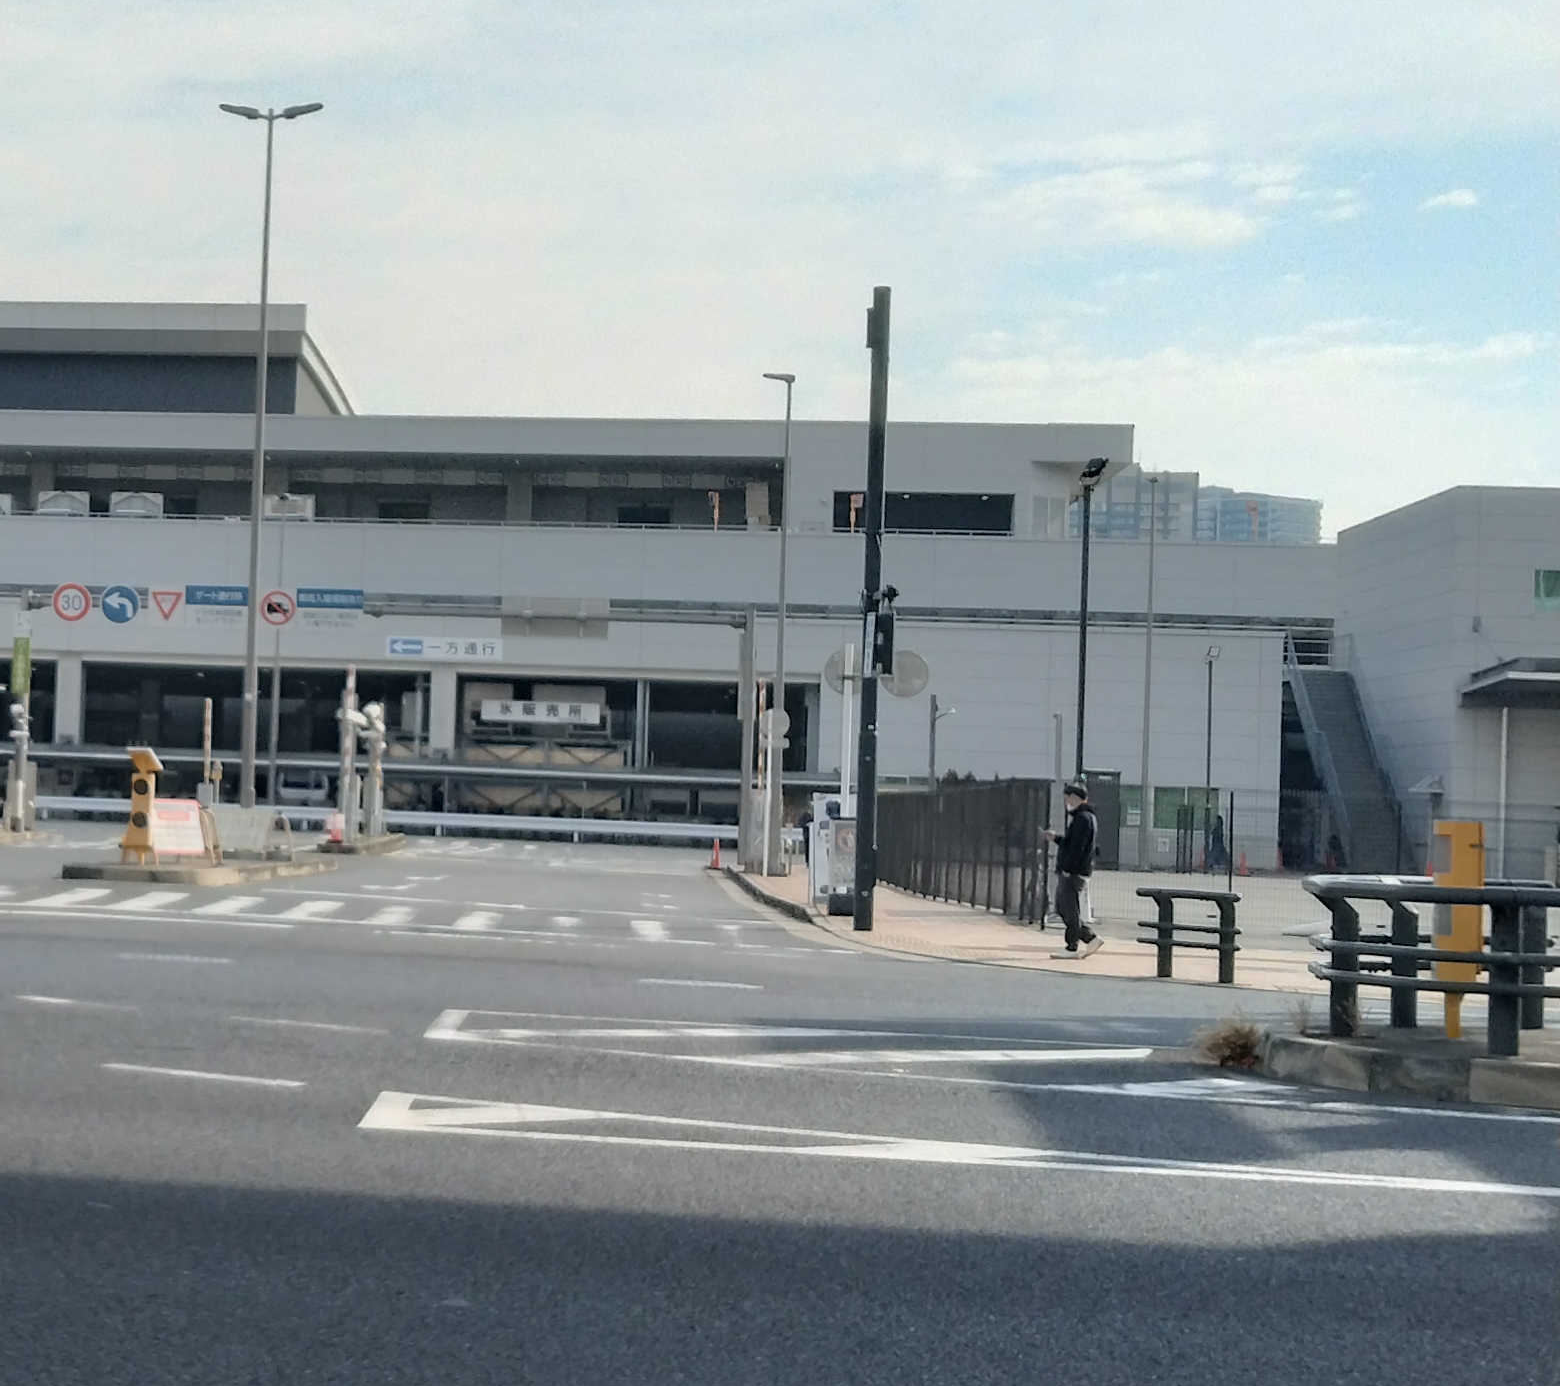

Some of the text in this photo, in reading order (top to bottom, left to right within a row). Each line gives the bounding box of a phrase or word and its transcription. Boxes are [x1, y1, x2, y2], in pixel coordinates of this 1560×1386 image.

[61, 594, 83, 611] 30
[427, 642, 496, 656] 一方通行
